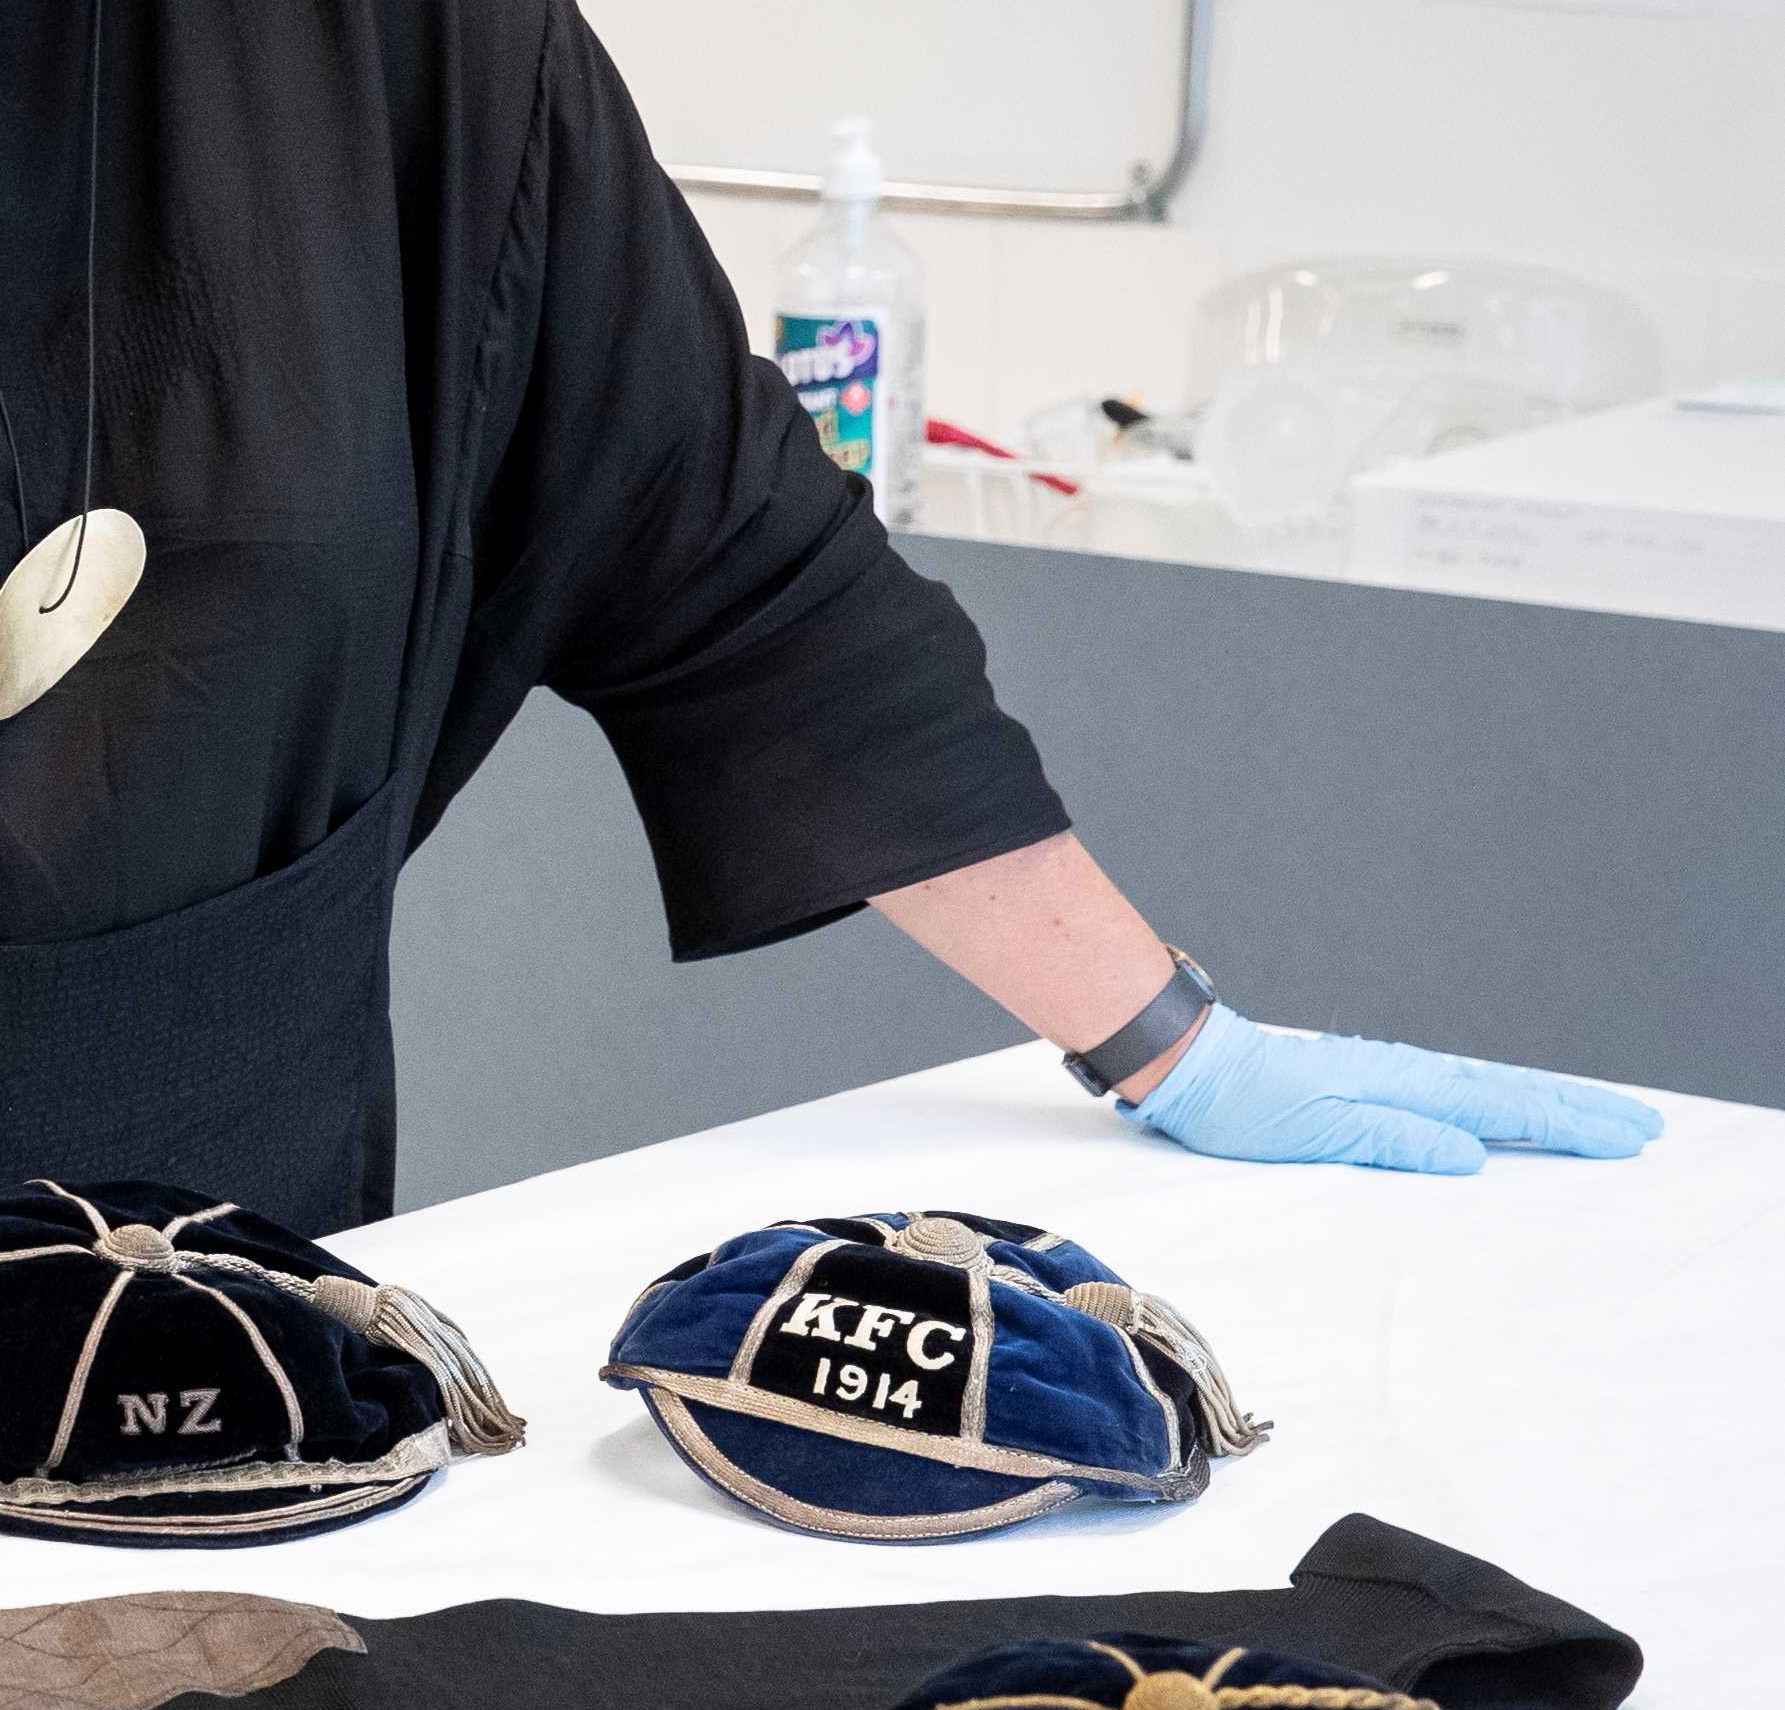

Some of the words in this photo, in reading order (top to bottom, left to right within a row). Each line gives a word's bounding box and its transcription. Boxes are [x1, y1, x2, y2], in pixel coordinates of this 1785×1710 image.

[779, 1292, 967, 1370] KFC
[117, 1387, 223, 1437] NZ
[813, 1356, 923, 1419] 1914
